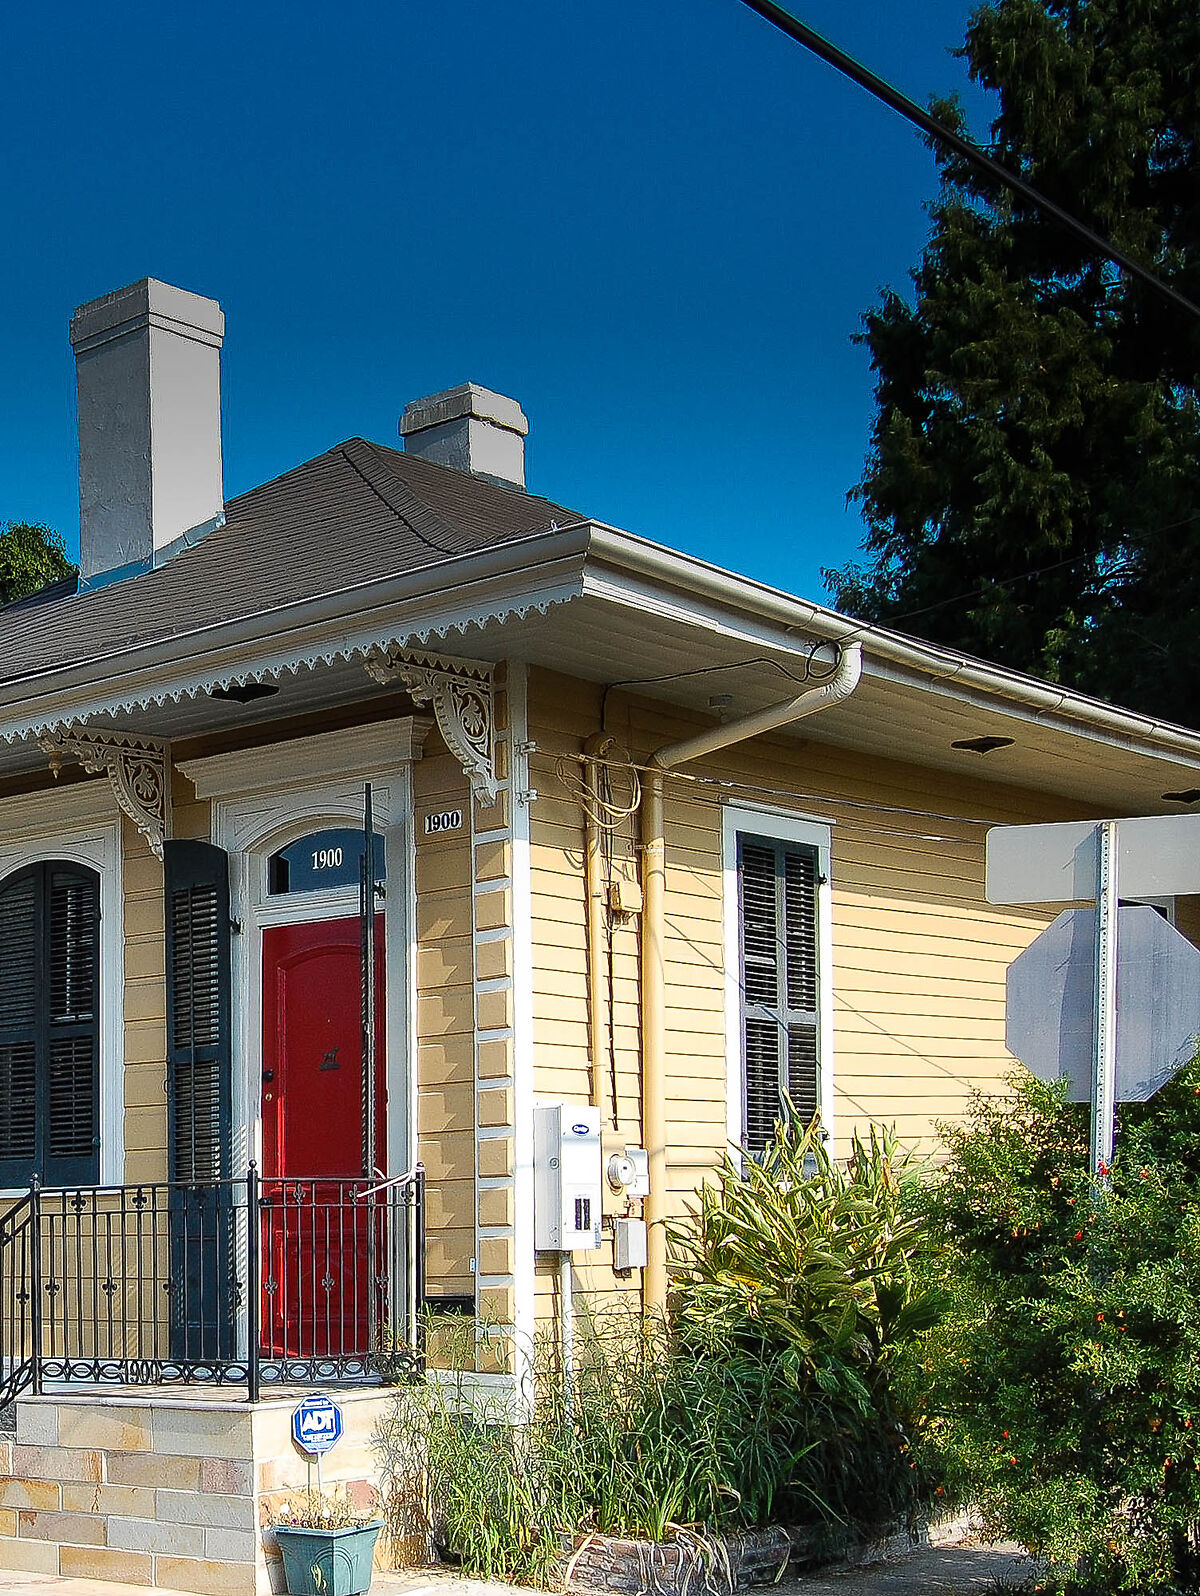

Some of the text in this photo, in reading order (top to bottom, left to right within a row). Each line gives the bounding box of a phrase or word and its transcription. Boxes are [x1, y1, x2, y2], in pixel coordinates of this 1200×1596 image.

[424, 811, 460, 833] 1900
[311, 847, 343, 870] 1900
[302, 1410, 332, 1432] ADT
